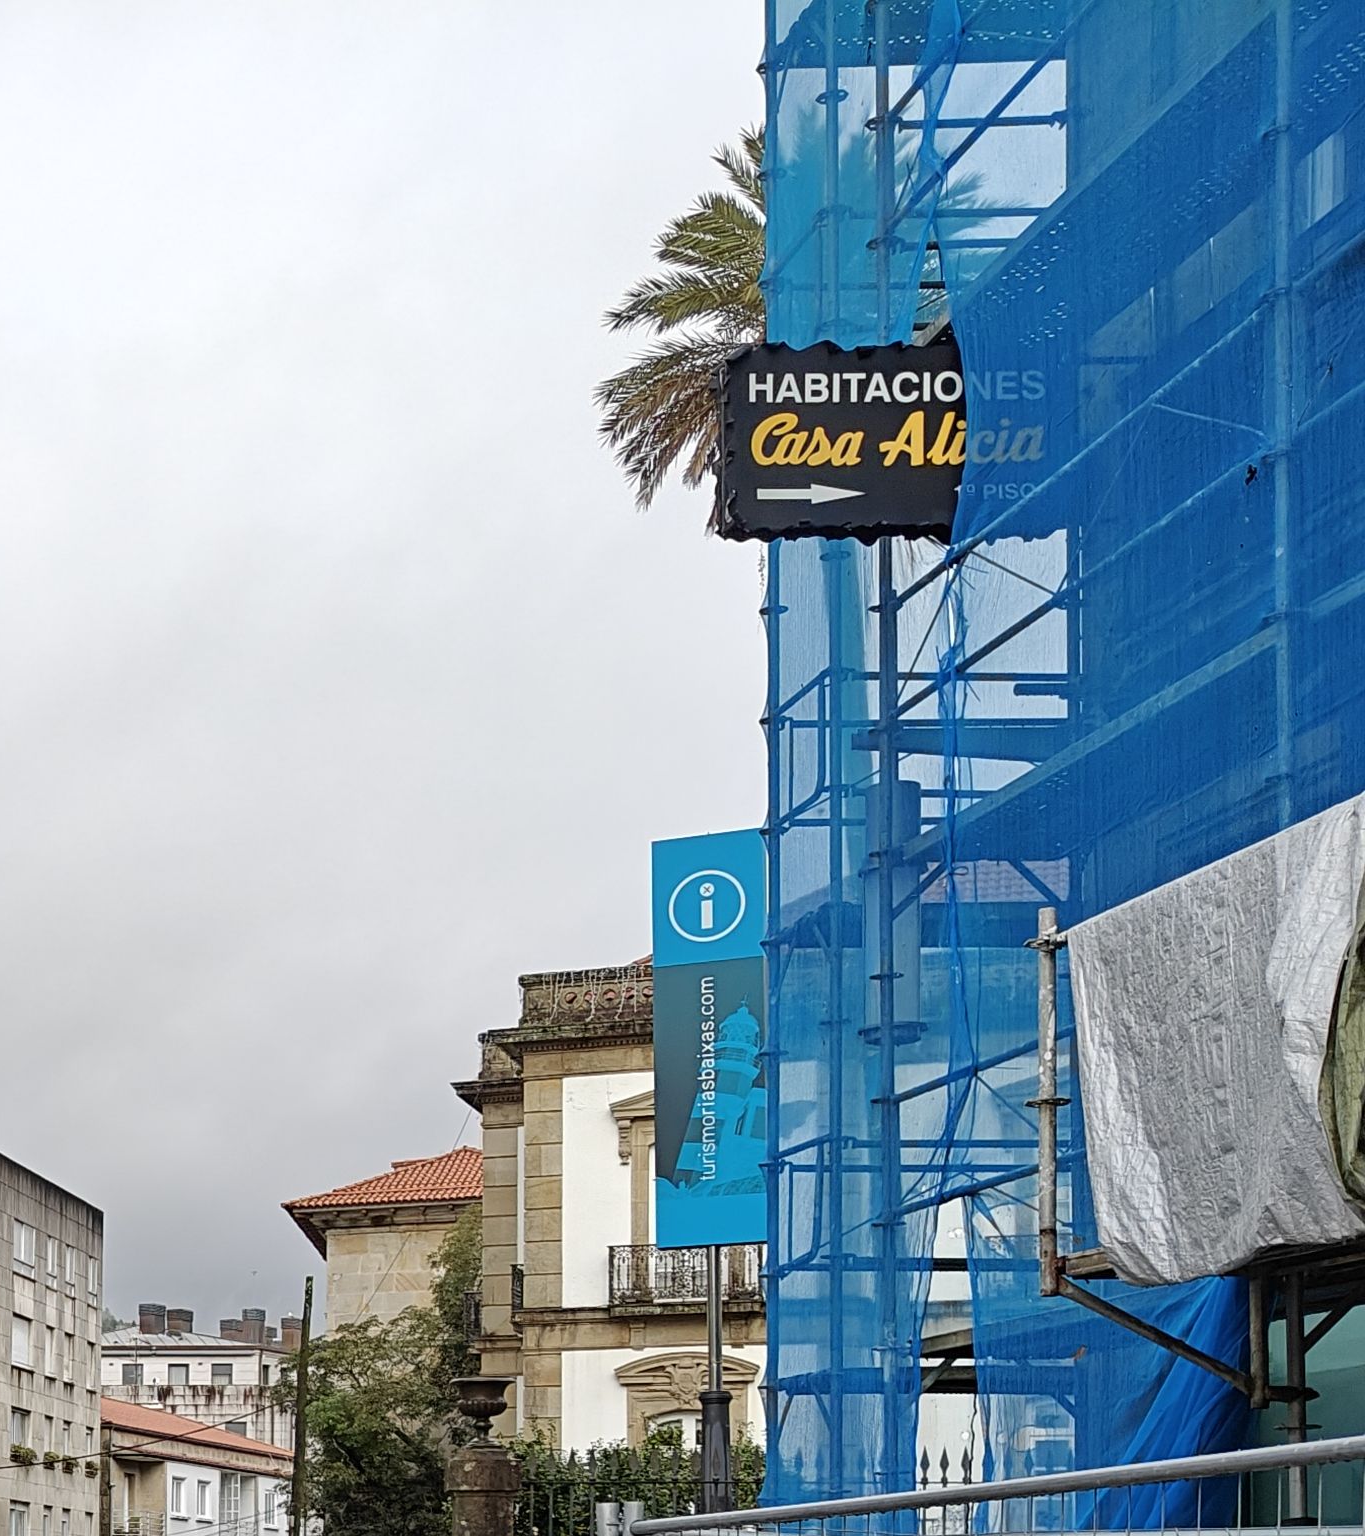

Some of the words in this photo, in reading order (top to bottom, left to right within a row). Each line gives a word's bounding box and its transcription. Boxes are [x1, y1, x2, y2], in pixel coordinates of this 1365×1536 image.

[749, 370, 1046, 404] HABITACIONES
[750, 411, 865, 468] Casa
[878, 410, 1045, 468] Alicia
[696, 975, 716, 1182] turismoriasbaixas.com
